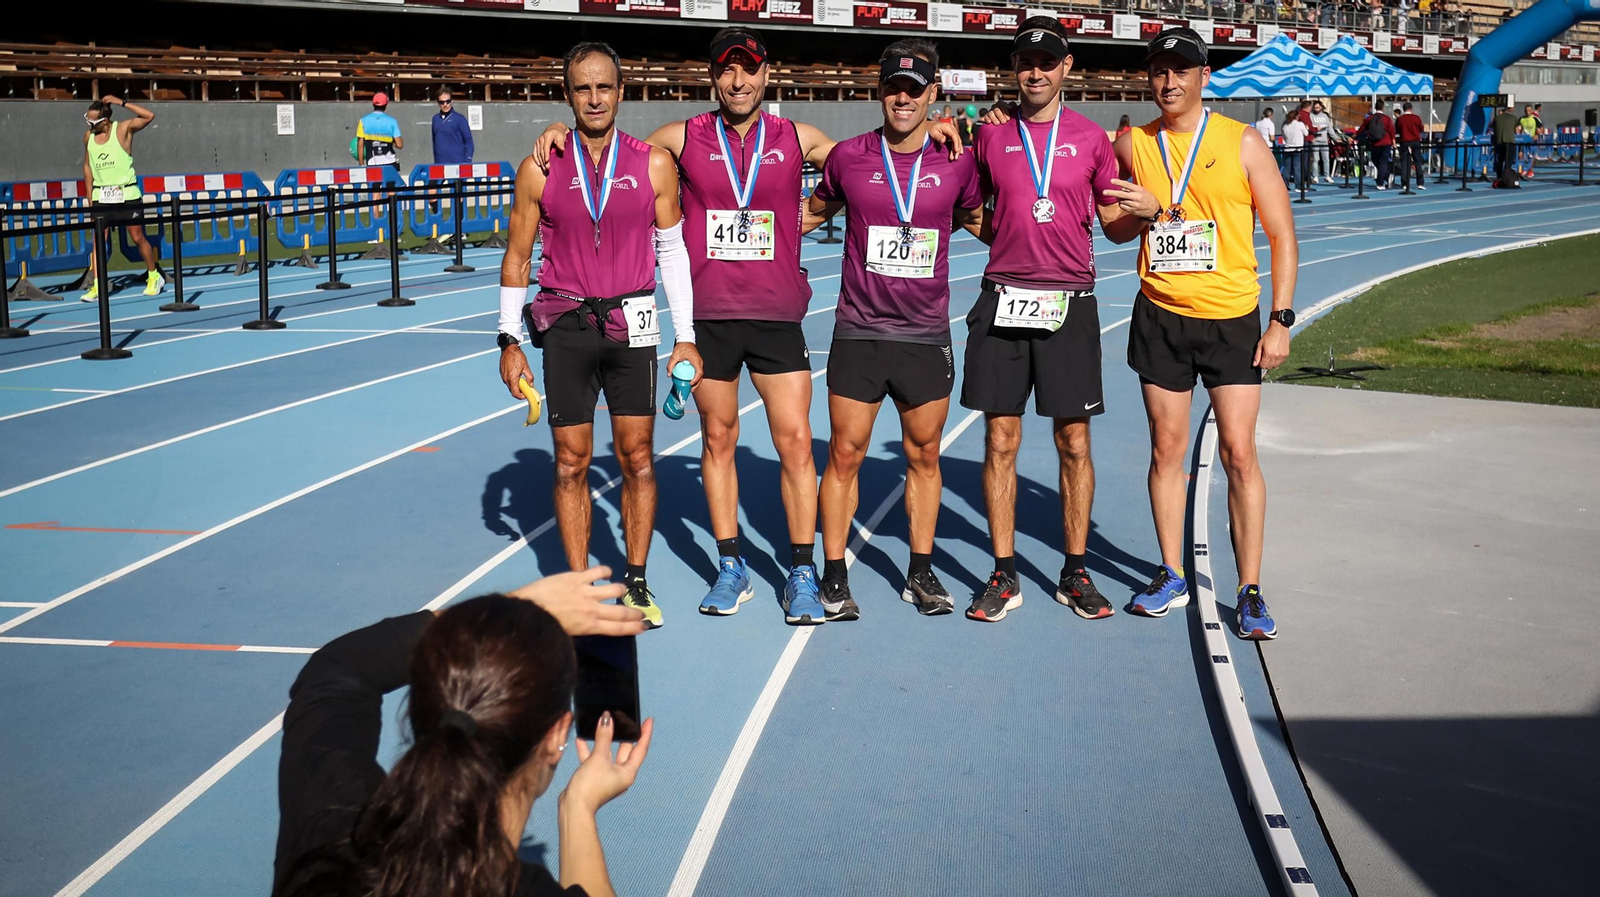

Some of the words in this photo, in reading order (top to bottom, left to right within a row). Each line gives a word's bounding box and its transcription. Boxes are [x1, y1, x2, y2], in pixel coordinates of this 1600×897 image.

[732, 0, 764, 11] PLAY
[758, 0, 801, 18] JEREZ
[857, 6, 886, 18] PLAY
[880, 7, 917, 24] JEREZ
[965, 12, 990, 24] PLAY
[985, 13, 1018, 30] JEREZ
[1076, 18, 1106, 34] JEREZ
[877, 239, 910, 260] 120
[1156, 234, 1188, 255] 384
[1007, 299, 1040, 317] 172
[637, 309, 652, 330] 37
